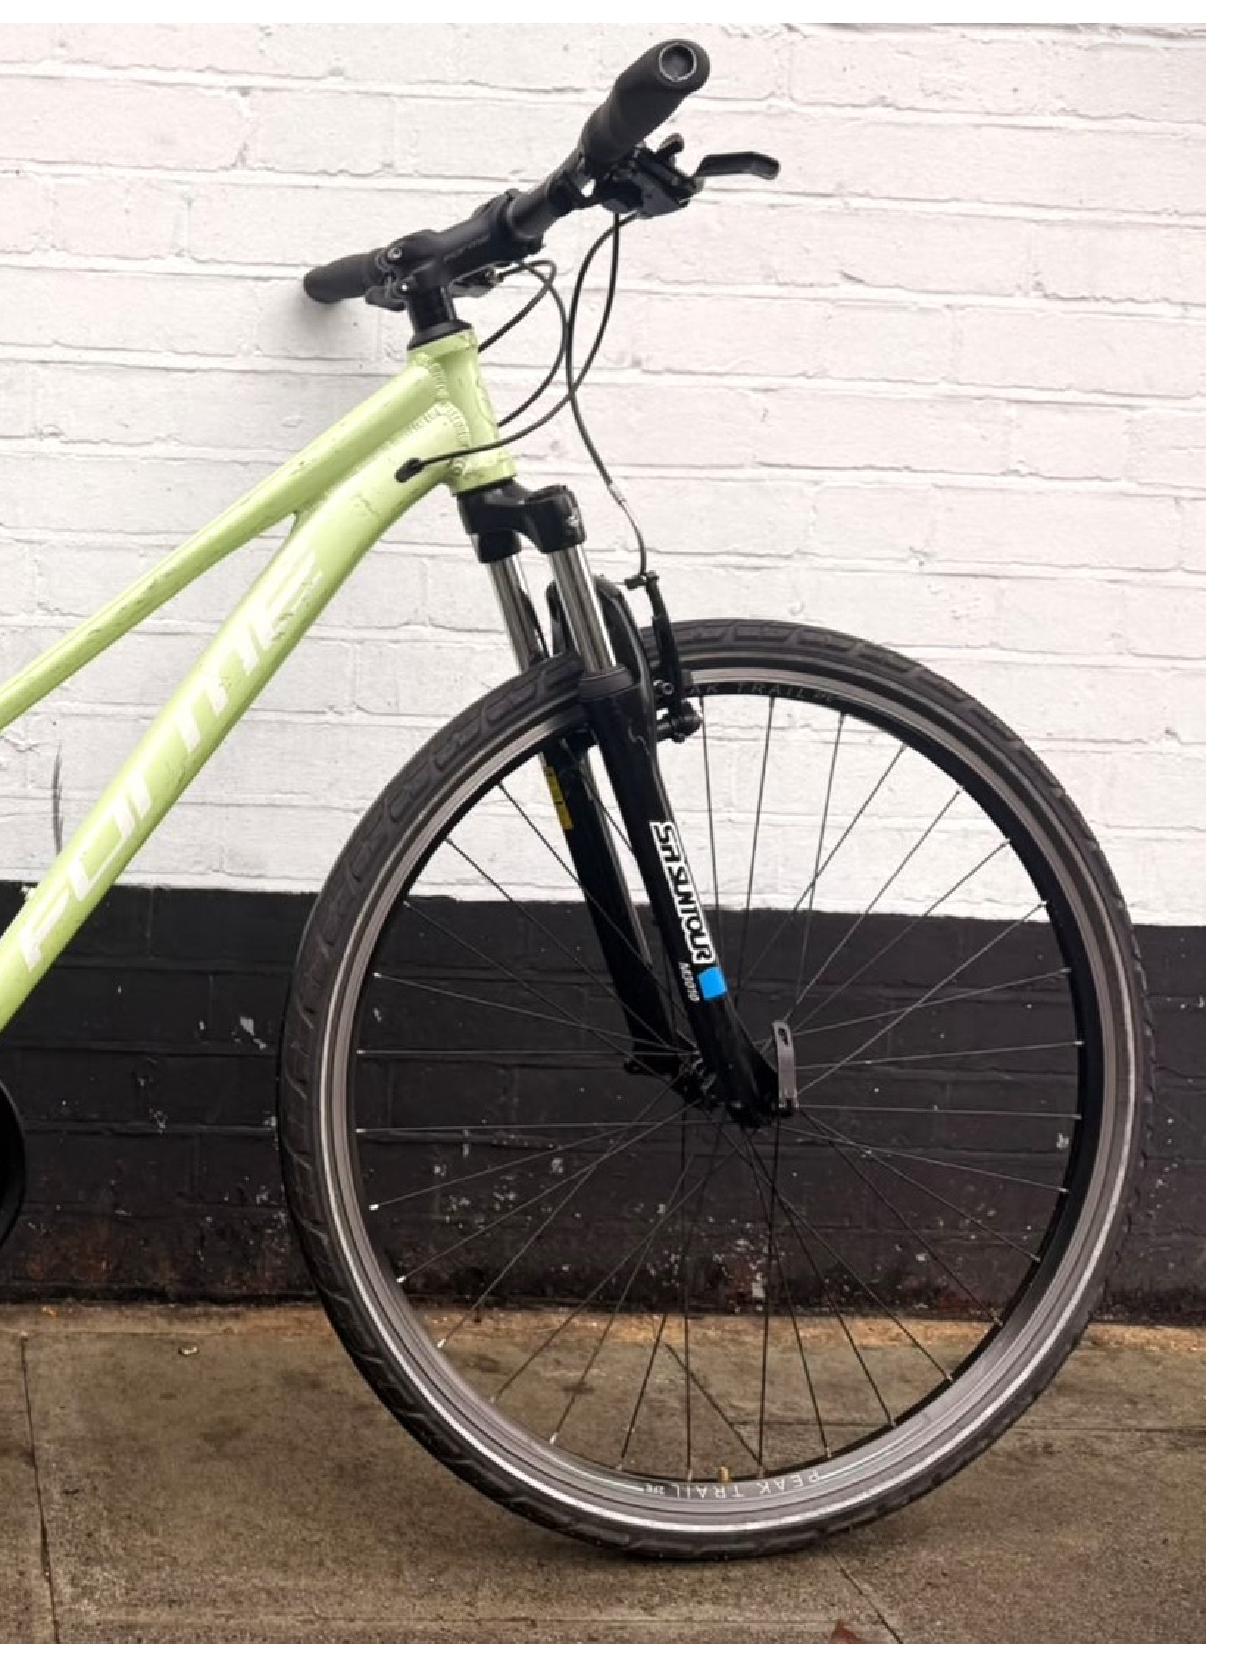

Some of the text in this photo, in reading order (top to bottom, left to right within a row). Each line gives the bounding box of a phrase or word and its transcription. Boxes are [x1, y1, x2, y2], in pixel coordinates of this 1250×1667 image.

[669, 864, 714, 963] SUNTOUR
[670, 1483, 744, 1499] TRAIL
[756, 1468, 820, 1496] PEAK
